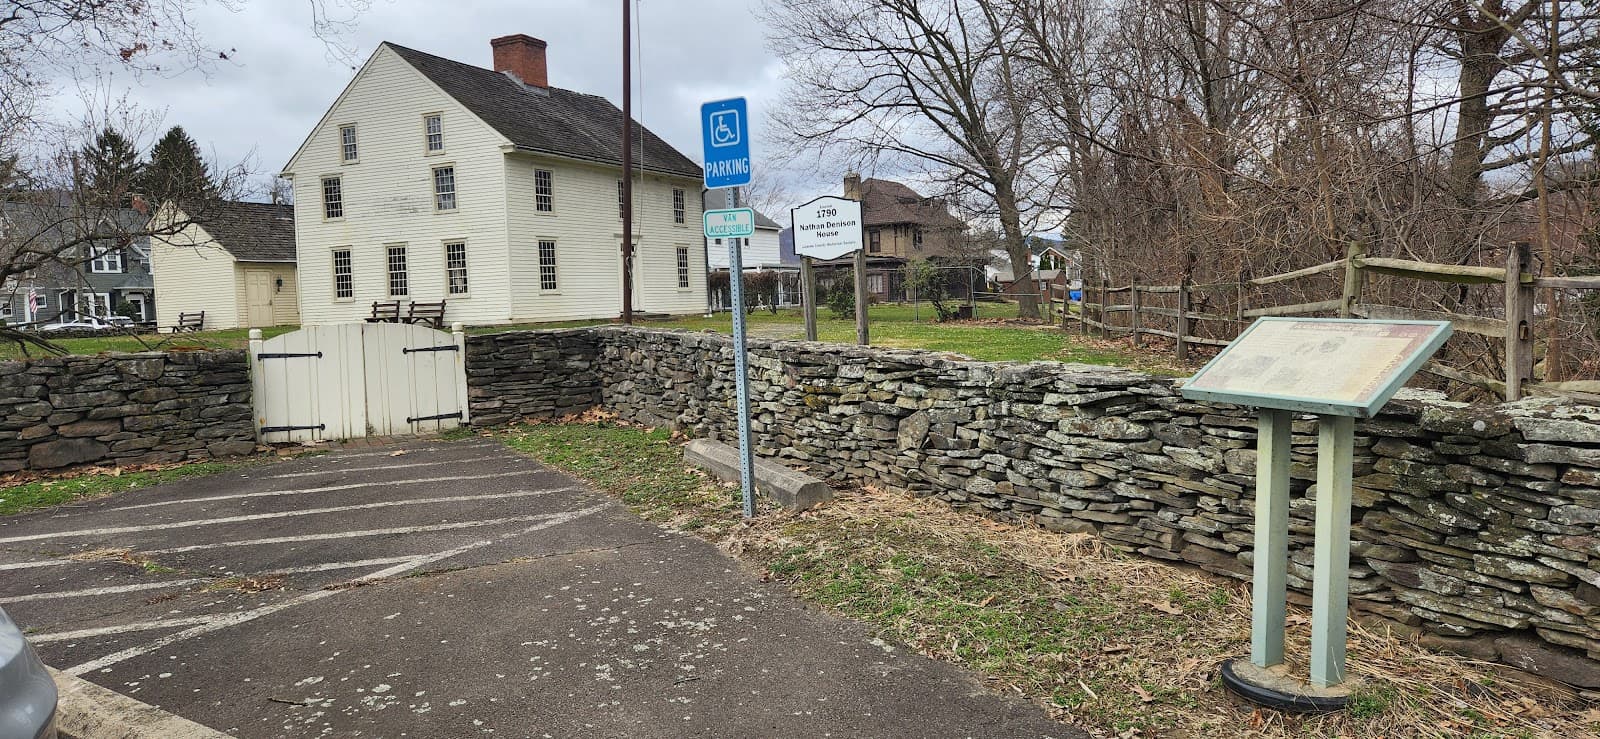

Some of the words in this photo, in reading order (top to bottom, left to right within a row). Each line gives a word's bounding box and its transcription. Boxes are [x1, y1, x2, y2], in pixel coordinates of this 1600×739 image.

[706, 157, 749, 178] PARKING
[723, 214, 737, 222] VAN
[816, 208, 837, 218] 1790
[709, 224, 750, 234] ACCESSIBLE
[800, 223, 825, 231] Nathan
[826, 220, 856, 229] Denison
